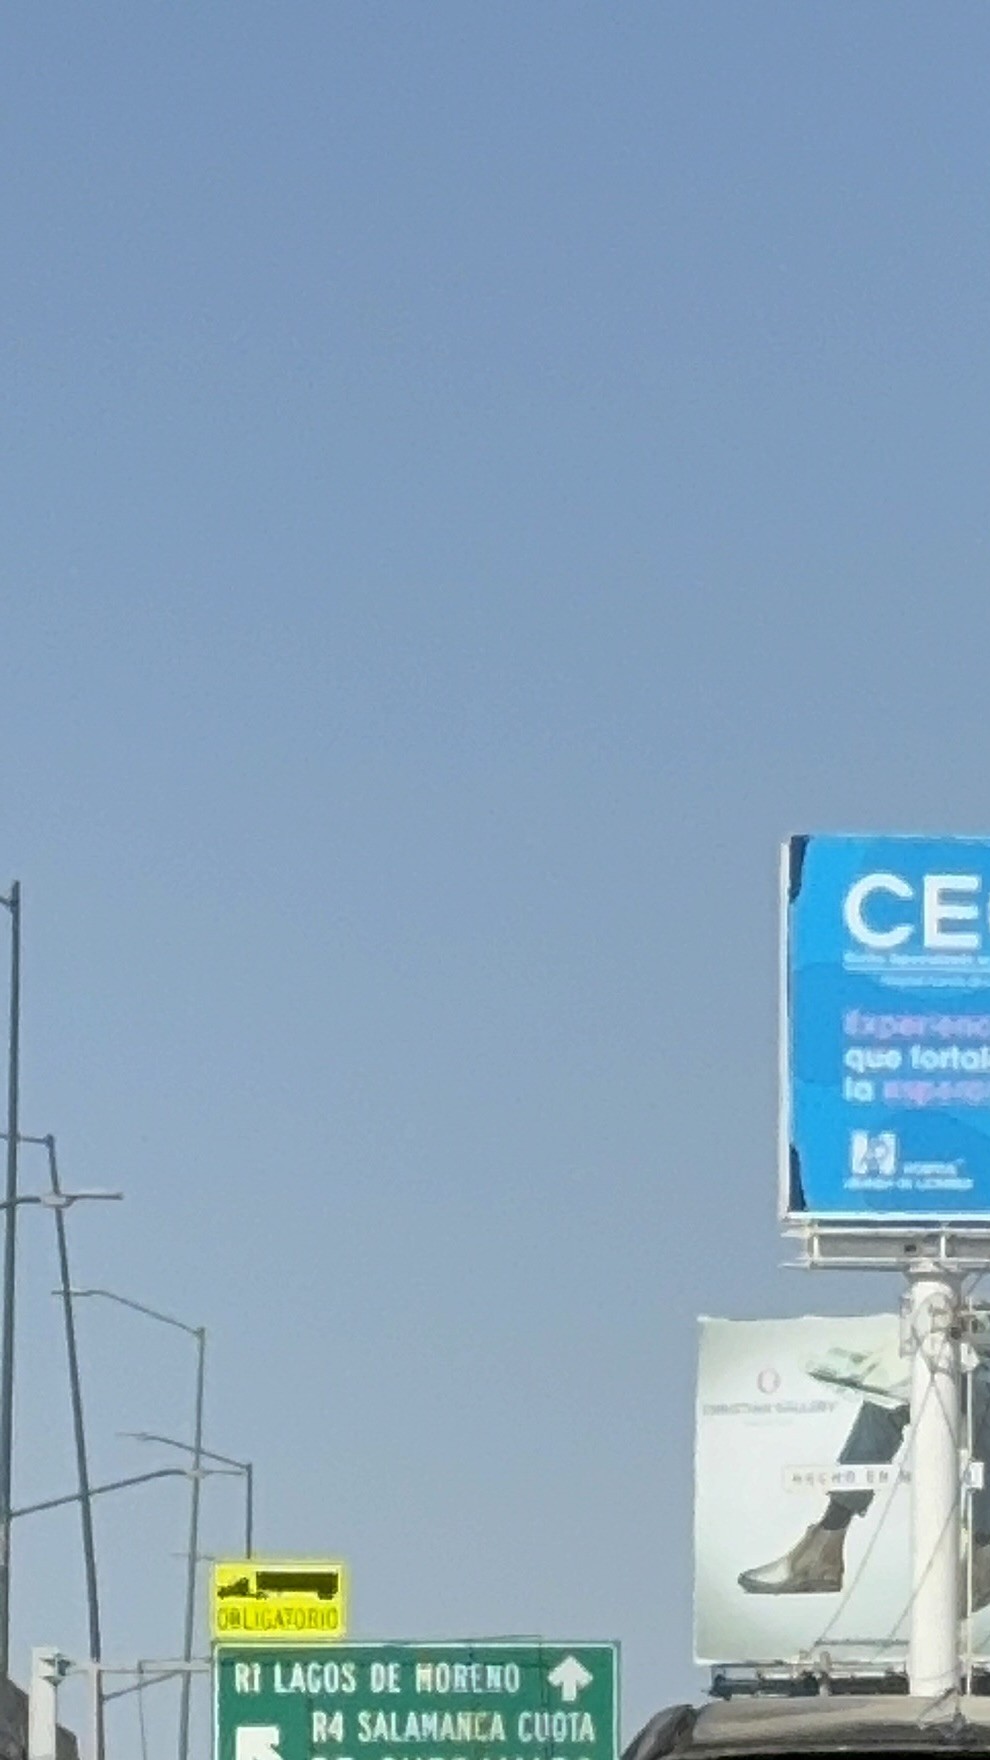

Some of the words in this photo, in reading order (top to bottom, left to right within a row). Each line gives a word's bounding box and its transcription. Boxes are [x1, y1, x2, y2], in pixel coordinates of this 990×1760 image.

[844, 1048, 902, 1073] que
[844, 1076, 873, 1102] la
[217, 1606, 339, 1631] OBLIGATORIO
[273, 1662, 357, 1693] LAGOS
[370, 1662, 401, 1693] DE
[416, 1662, 521, 1693] MORENO
[311, 1711, 344, 1743] R4
[357, 1711, 505, 1743] SALAMANCA
[517, 1711, 596, 1743] CUOTA
